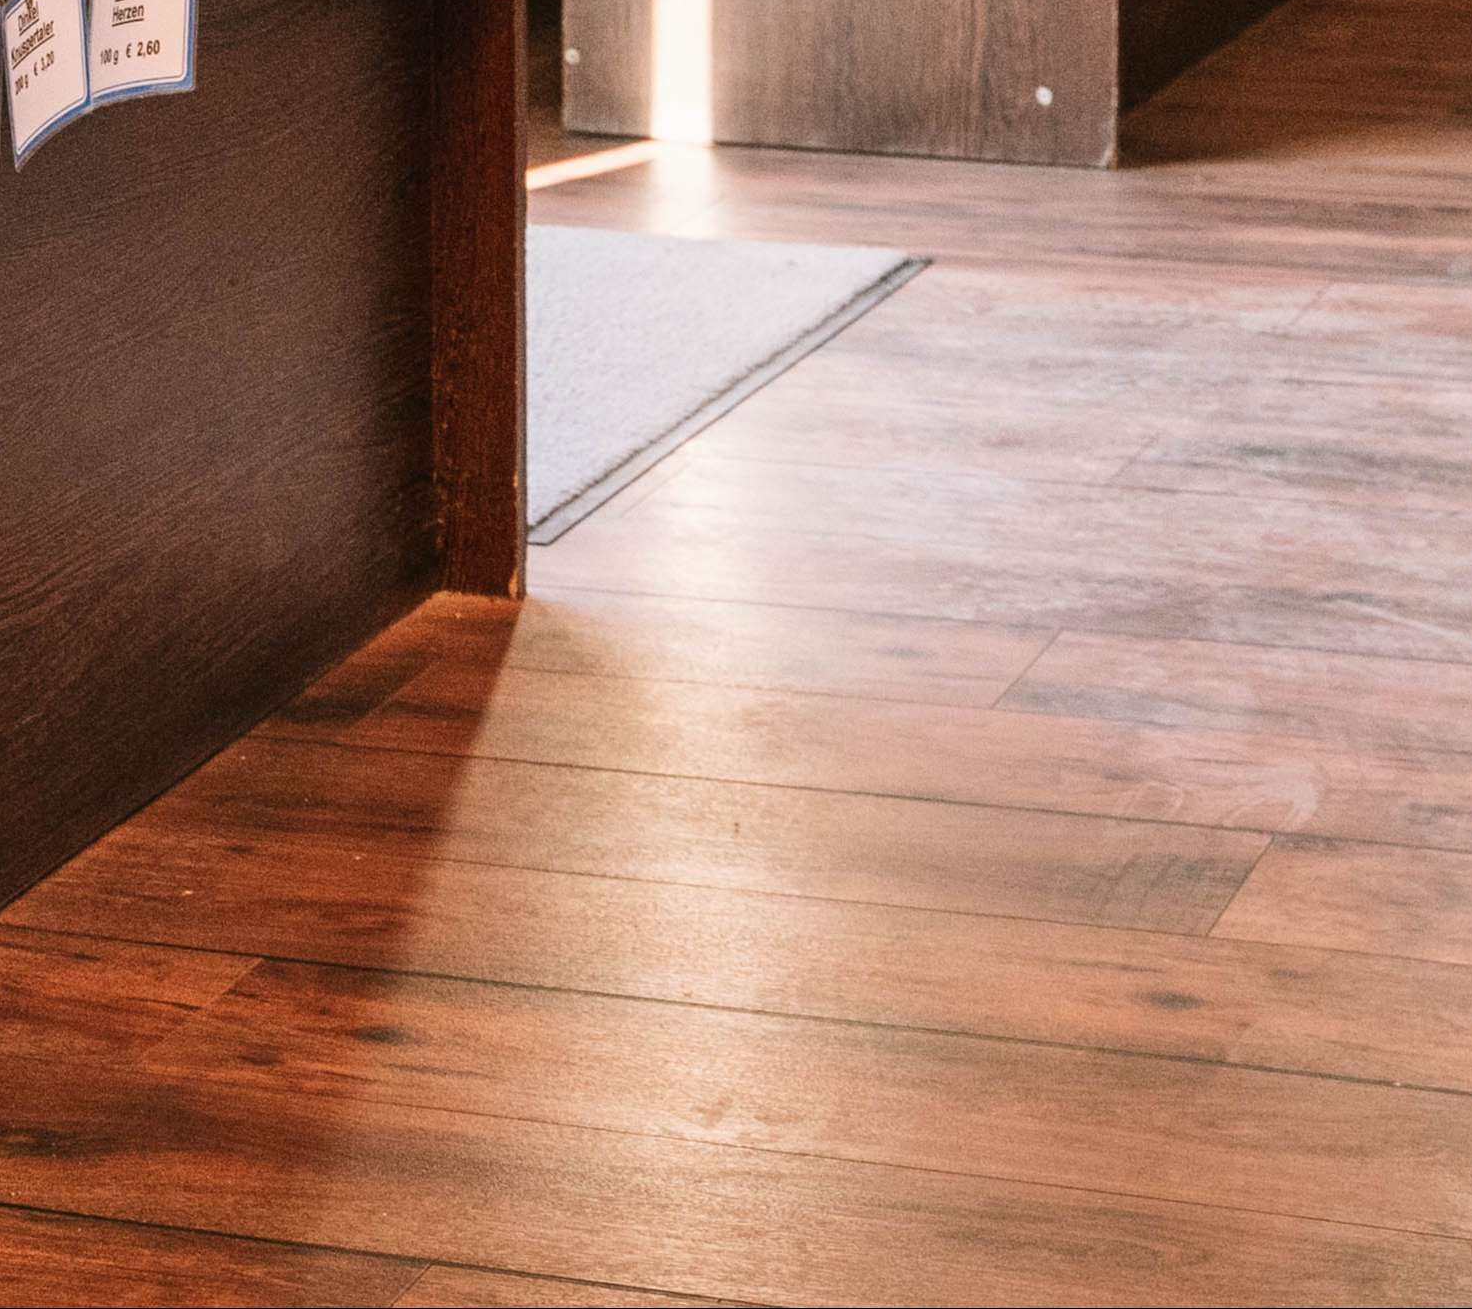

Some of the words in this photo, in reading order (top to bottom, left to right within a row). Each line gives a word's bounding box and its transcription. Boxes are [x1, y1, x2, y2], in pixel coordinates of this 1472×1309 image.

[16, 0, 39, 33] Dinkel
[112, 0, 145, 22] Herzen
[9, 18, 55, 65] Knuspertaler
